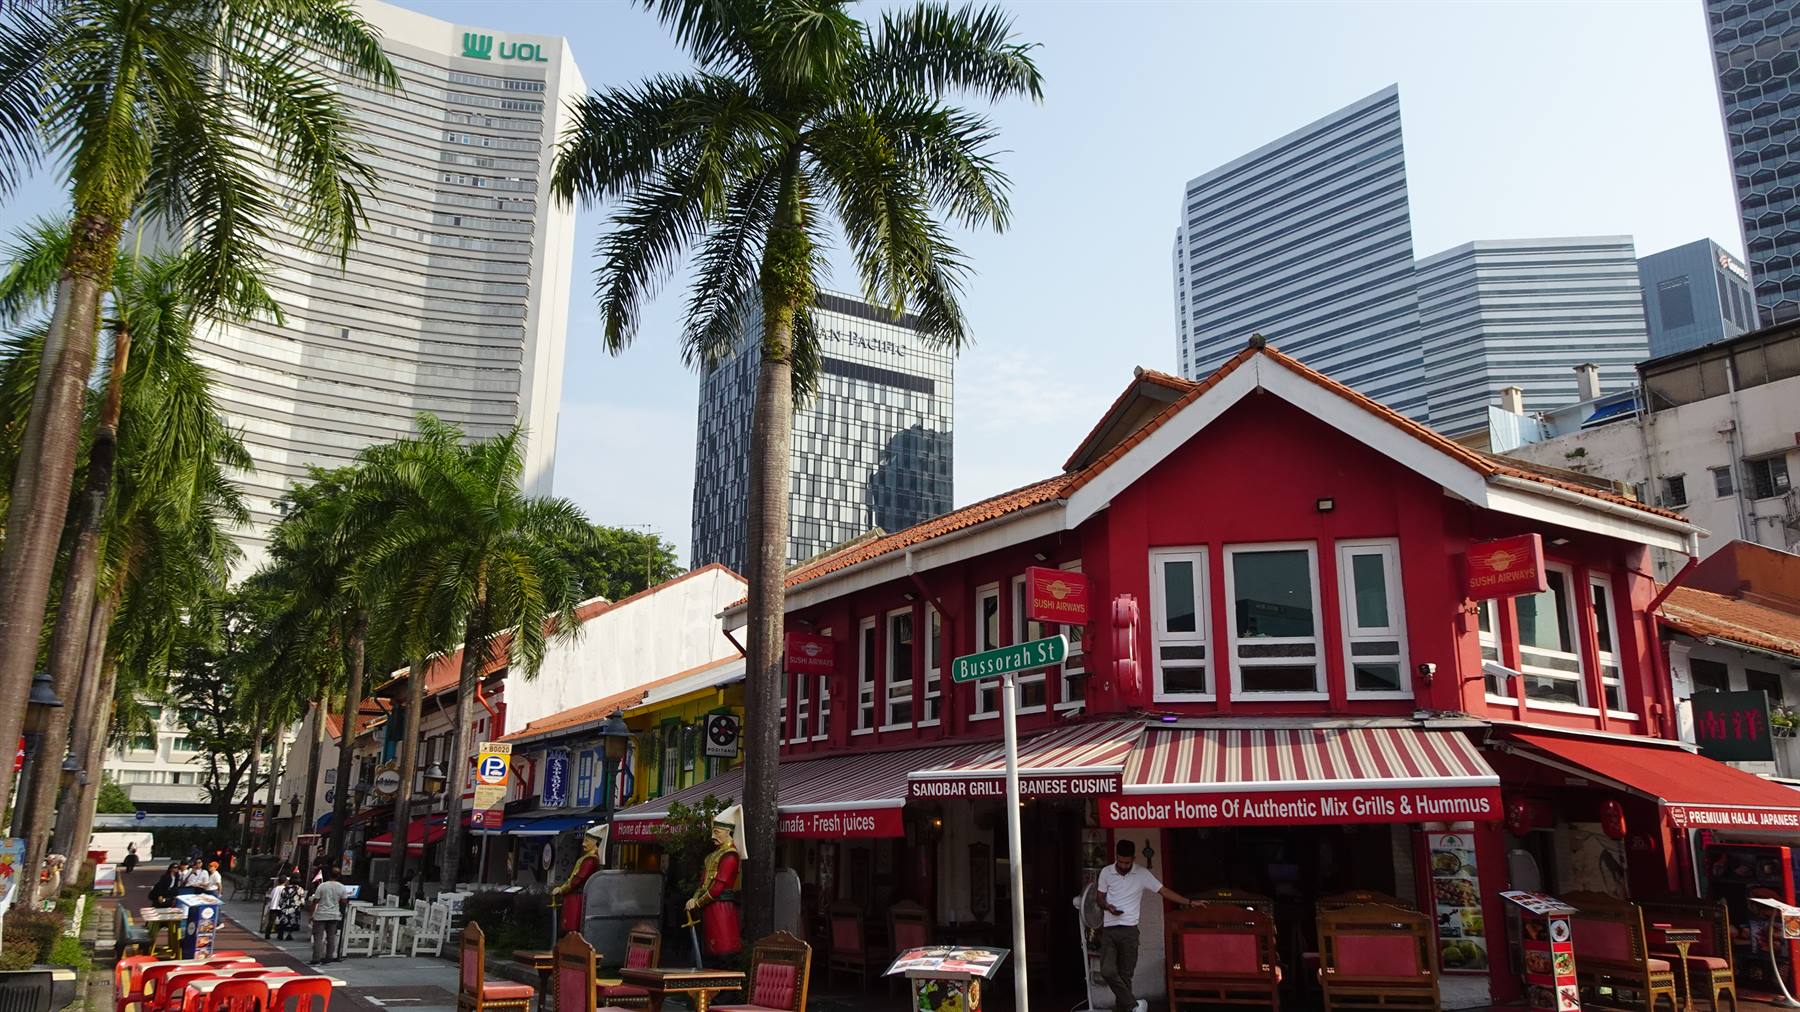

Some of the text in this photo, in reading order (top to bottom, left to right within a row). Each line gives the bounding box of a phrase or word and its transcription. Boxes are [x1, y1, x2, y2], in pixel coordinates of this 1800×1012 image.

[499, 42, 548, 62] UOL
[848, 330, 906, 357] PACIFIC
[1470, 567, 1535, 588] SUSHI AIRWAYS
[1033, 598, 1086, 613] SUSHI AIRWAYS
[790, 656, 808, 665] SUSHI
[960, 642, 1055, 678] Bussorah St
[912, 778, 1117, 797] SANOBAR GRILL BANESE CUSINE
[1109, 794, 1490, 821] Sanobar Home Of Authentic Mix Grills & Hummus
[618, 822, 634, 835] Home
[634, 821, 642, 835] of
[779, 813, 875, 836] unafa Fresh juices
[1689, 811, 1731, 824] PREMIUM
[1731, 812, 1759, 825] HALAL
[1760, 813, 1799, 826] JAPANESE
